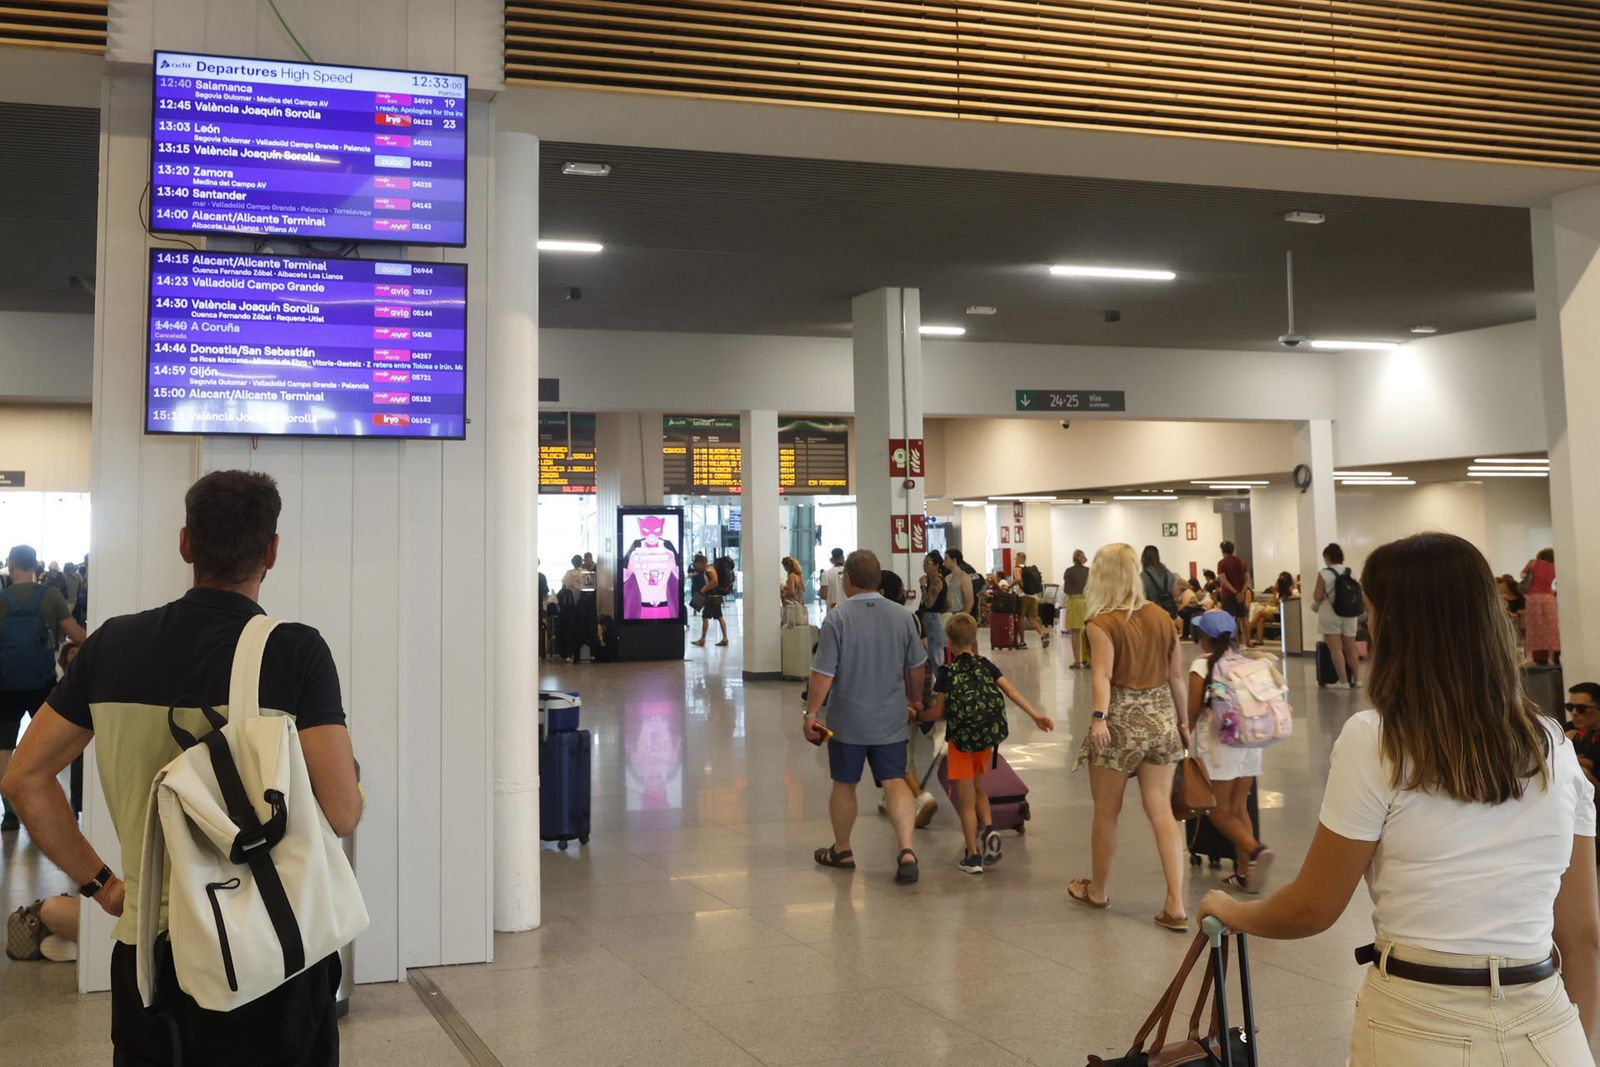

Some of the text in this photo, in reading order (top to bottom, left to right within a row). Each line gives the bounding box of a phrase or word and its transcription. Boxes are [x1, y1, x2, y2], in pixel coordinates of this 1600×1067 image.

[196, 61, 353, 84] Departures High Speed
[160, 78, 252, 92] 12:40 Salamanca
[195, 91, 222, 100] Segovia
[160, 100, 321, 119] 12:45 València Joaquín Sorolla
[444, 99, 455, 108] 19
[401, 106, 432, 115] Apologies
[159, 121, 220, 134] 13:03 León
[443, 120, 456, 129] 23
[194, 134, 221, 144] Segovia
[256, 138, 288, 147] Valladolid
[290, 141, 314, 150] Campo
[315, 142, 338, 150] Grande
[344, 144, 370, 152] Palencia
[158, 142, 320, 161] 13:15 València Joaquín Sorolla
[158, 165, 233, 178] 13:20 Zamora
[157, 187, 247, 200] 13:40 Santander
[212, 201, 245, 209] Valladolid
[246, 203, 270, 211] Campo
[333, 208, 372, 216] Torrelavega
[156, 209, 326, 227] 14:00 Alacant/Alicante Terminal
[192, 222, 222, 230] Albacete
[157, 254, 327, 271] 14:15 Alacant/Alicante Terminal
[192, 267, 218, 275] Cuenca
[220, 268, 251, 276] Fernando
[157, 276, 325, 292] 14:23 Valladolid Campo Grande
[156, 298, 319, 314] 14:30 València Joaquín Sorolla
[219, 312, 251, 320] Fernando
[155, 320, 240, 333] 14:40 A Coruña
[155, 342, 315, 357] 14:46 Donostia/San Sebastián
[154, 366, 217, 377] 14:59 Gijón
[153, 388, 325, 401] 15:00 Alacant/Alicante Terminal
[384, 416, 399, 424] iryo
[704, 529, 718, 544] 24
